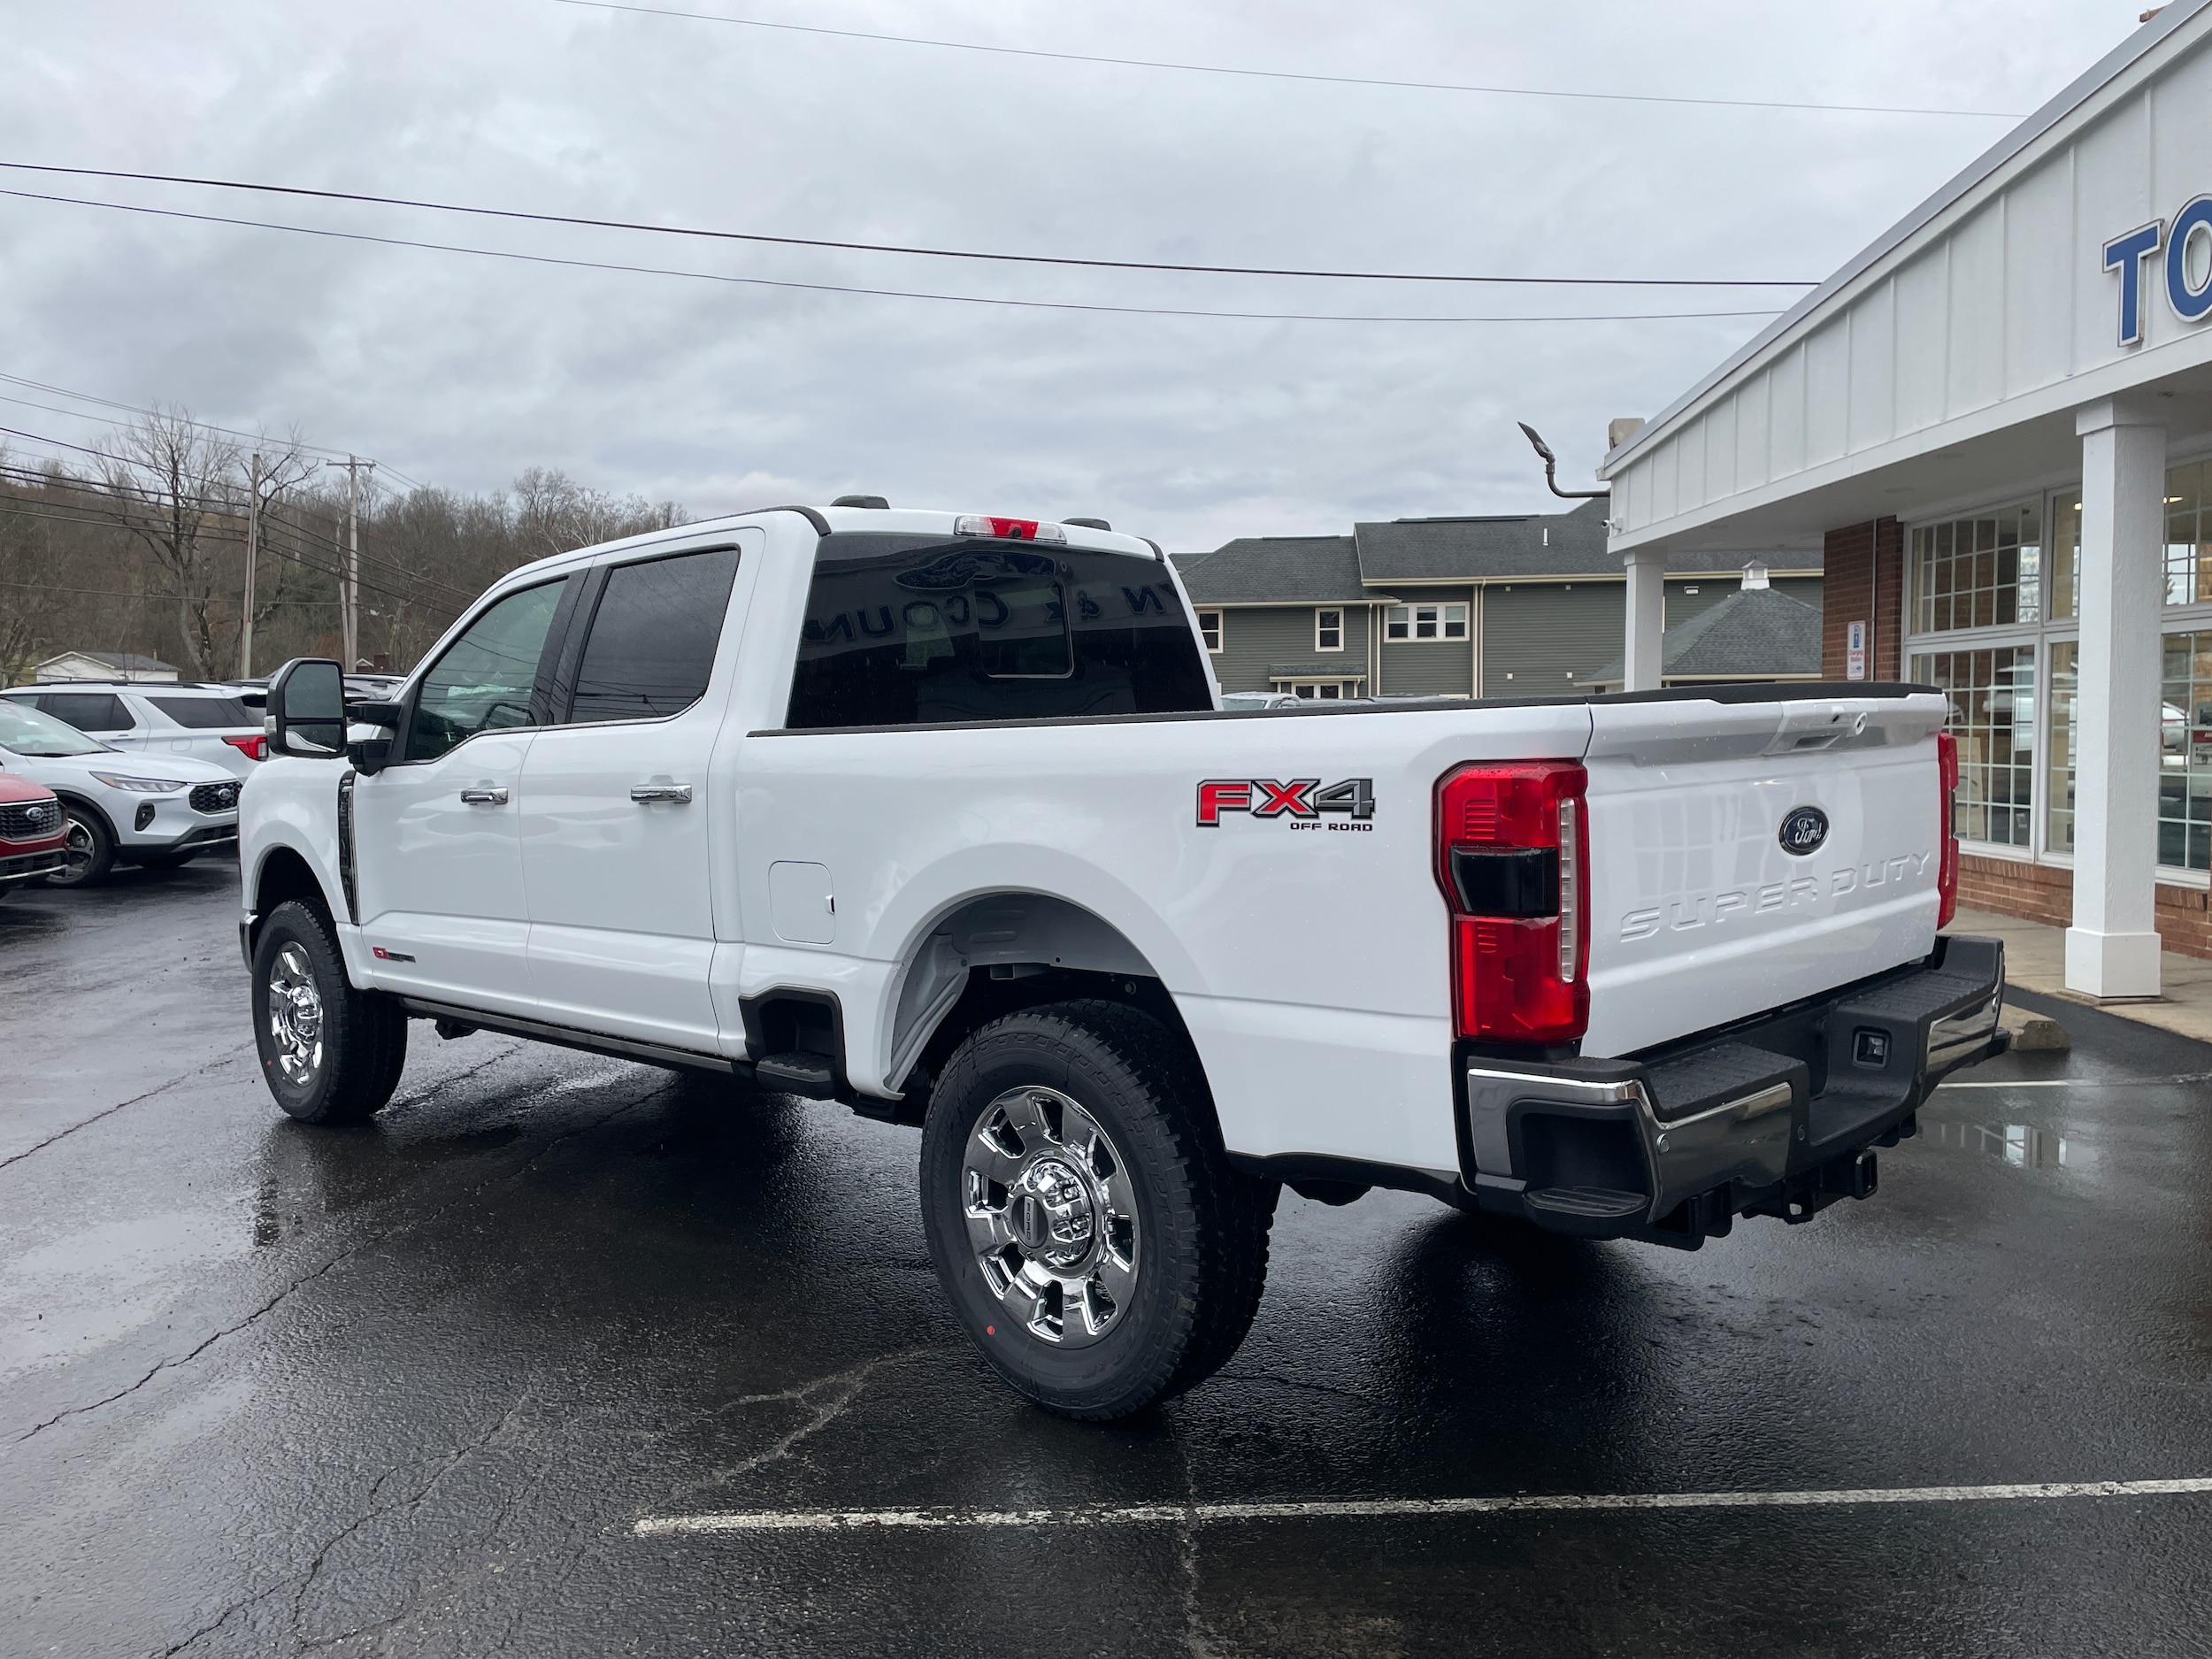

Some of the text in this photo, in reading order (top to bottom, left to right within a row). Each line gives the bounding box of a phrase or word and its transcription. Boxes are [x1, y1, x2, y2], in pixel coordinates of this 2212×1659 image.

[1195, 777, 1376, 828] FX4
[1290, 822, 1373, 832] OFF ROAD
[1620, 850, 1931, 943] SUPER DUTY
